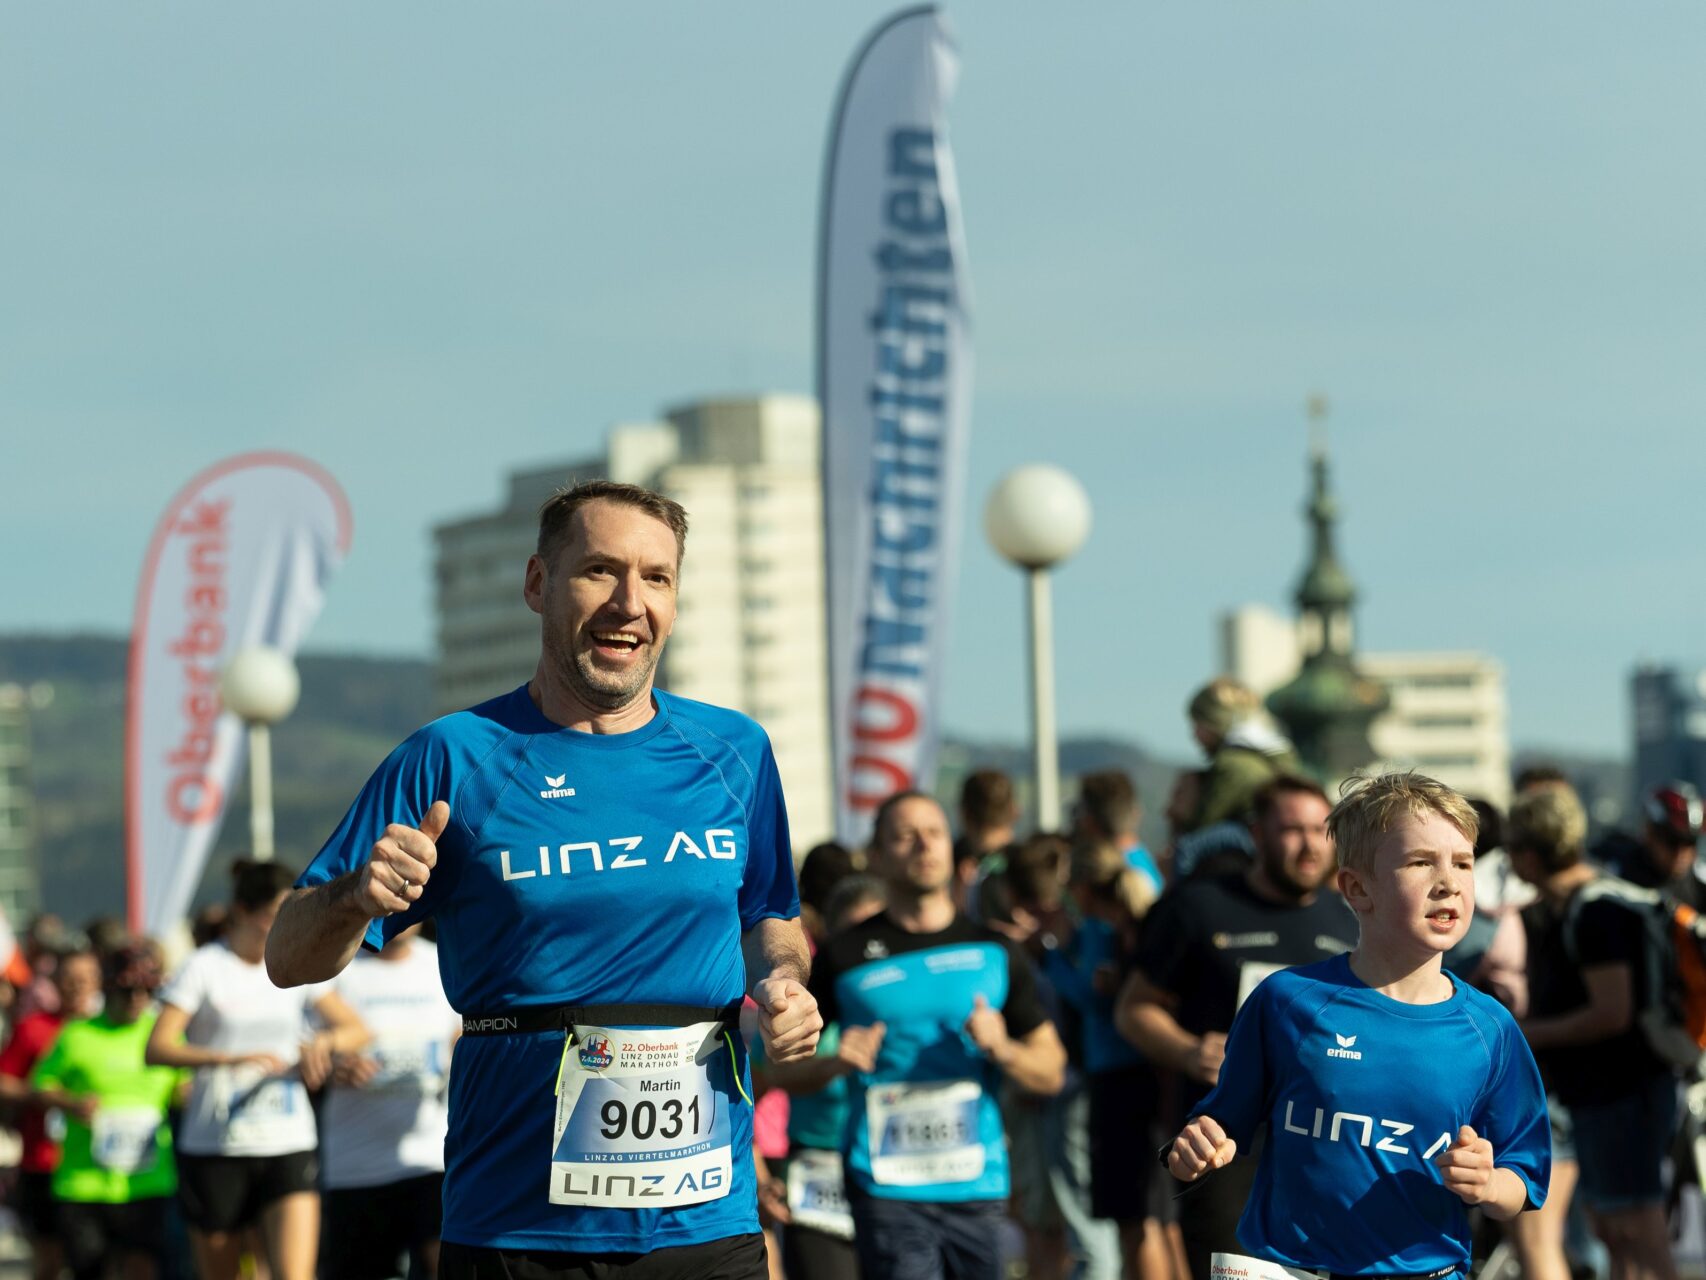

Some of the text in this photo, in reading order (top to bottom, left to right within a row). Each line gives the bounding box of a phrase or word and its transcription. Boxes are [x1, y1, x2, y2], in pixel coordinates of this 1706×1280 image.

[164, 496, 234, 825] Oberbank
[540, 786, 576, 799] erima
[500, 829, 737, 881] LINZ AG
[463, 1017, 517, 1031] HAMPION
[622, 1043, 636, 1051] 22.
[638, 1042, 678, 1051] Oberbank
[1326, 1048, 1362, 1060] erima
[647, 1052, 679, 1060] DONAU
[640, 1079, 681, 1092] Martin
[600, 1094, 700, 1140] 9031
[1284, 1100, 1452, 1160] LINZ A
[628, 1142, 711, 1160] VIERTELMARATHON
[563, 1166, 722, 1197] LINZ AG
